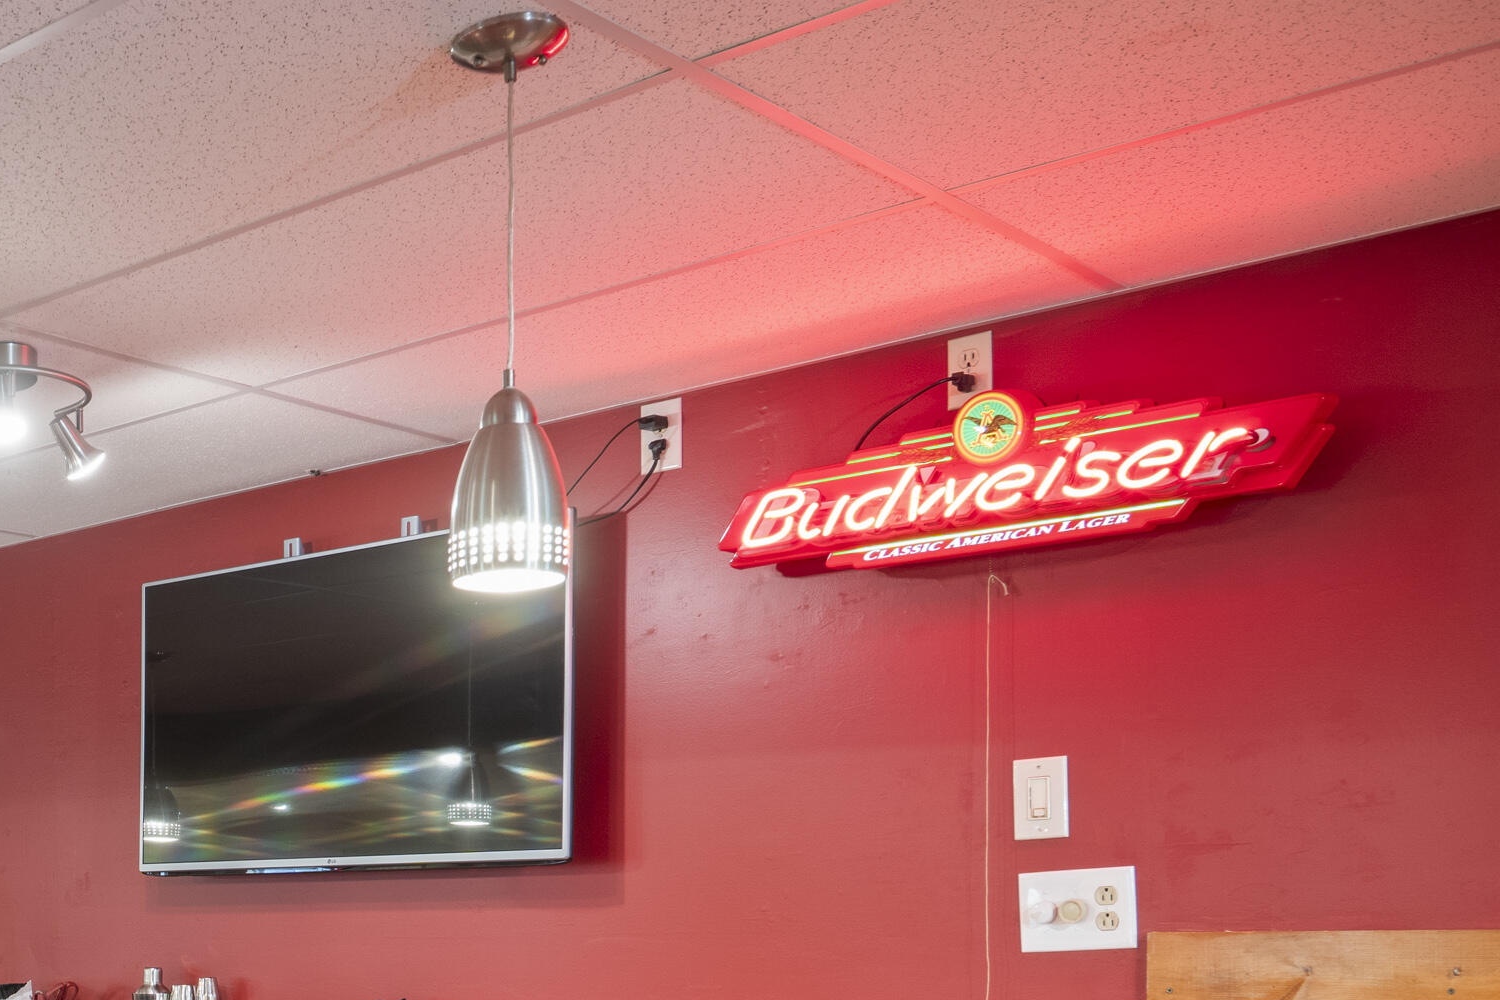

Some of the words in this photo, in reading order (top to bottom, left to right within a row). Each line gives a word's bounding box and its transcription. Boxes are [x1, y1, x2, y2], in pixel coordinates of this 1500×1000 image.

[741, 426, 1254, 549] Budweiser
[862, 541, 944, 562] CLASSIC
[946, 524, 1053, 549] AMERICAN
[1057, 513, 1131, 533] LAGER
